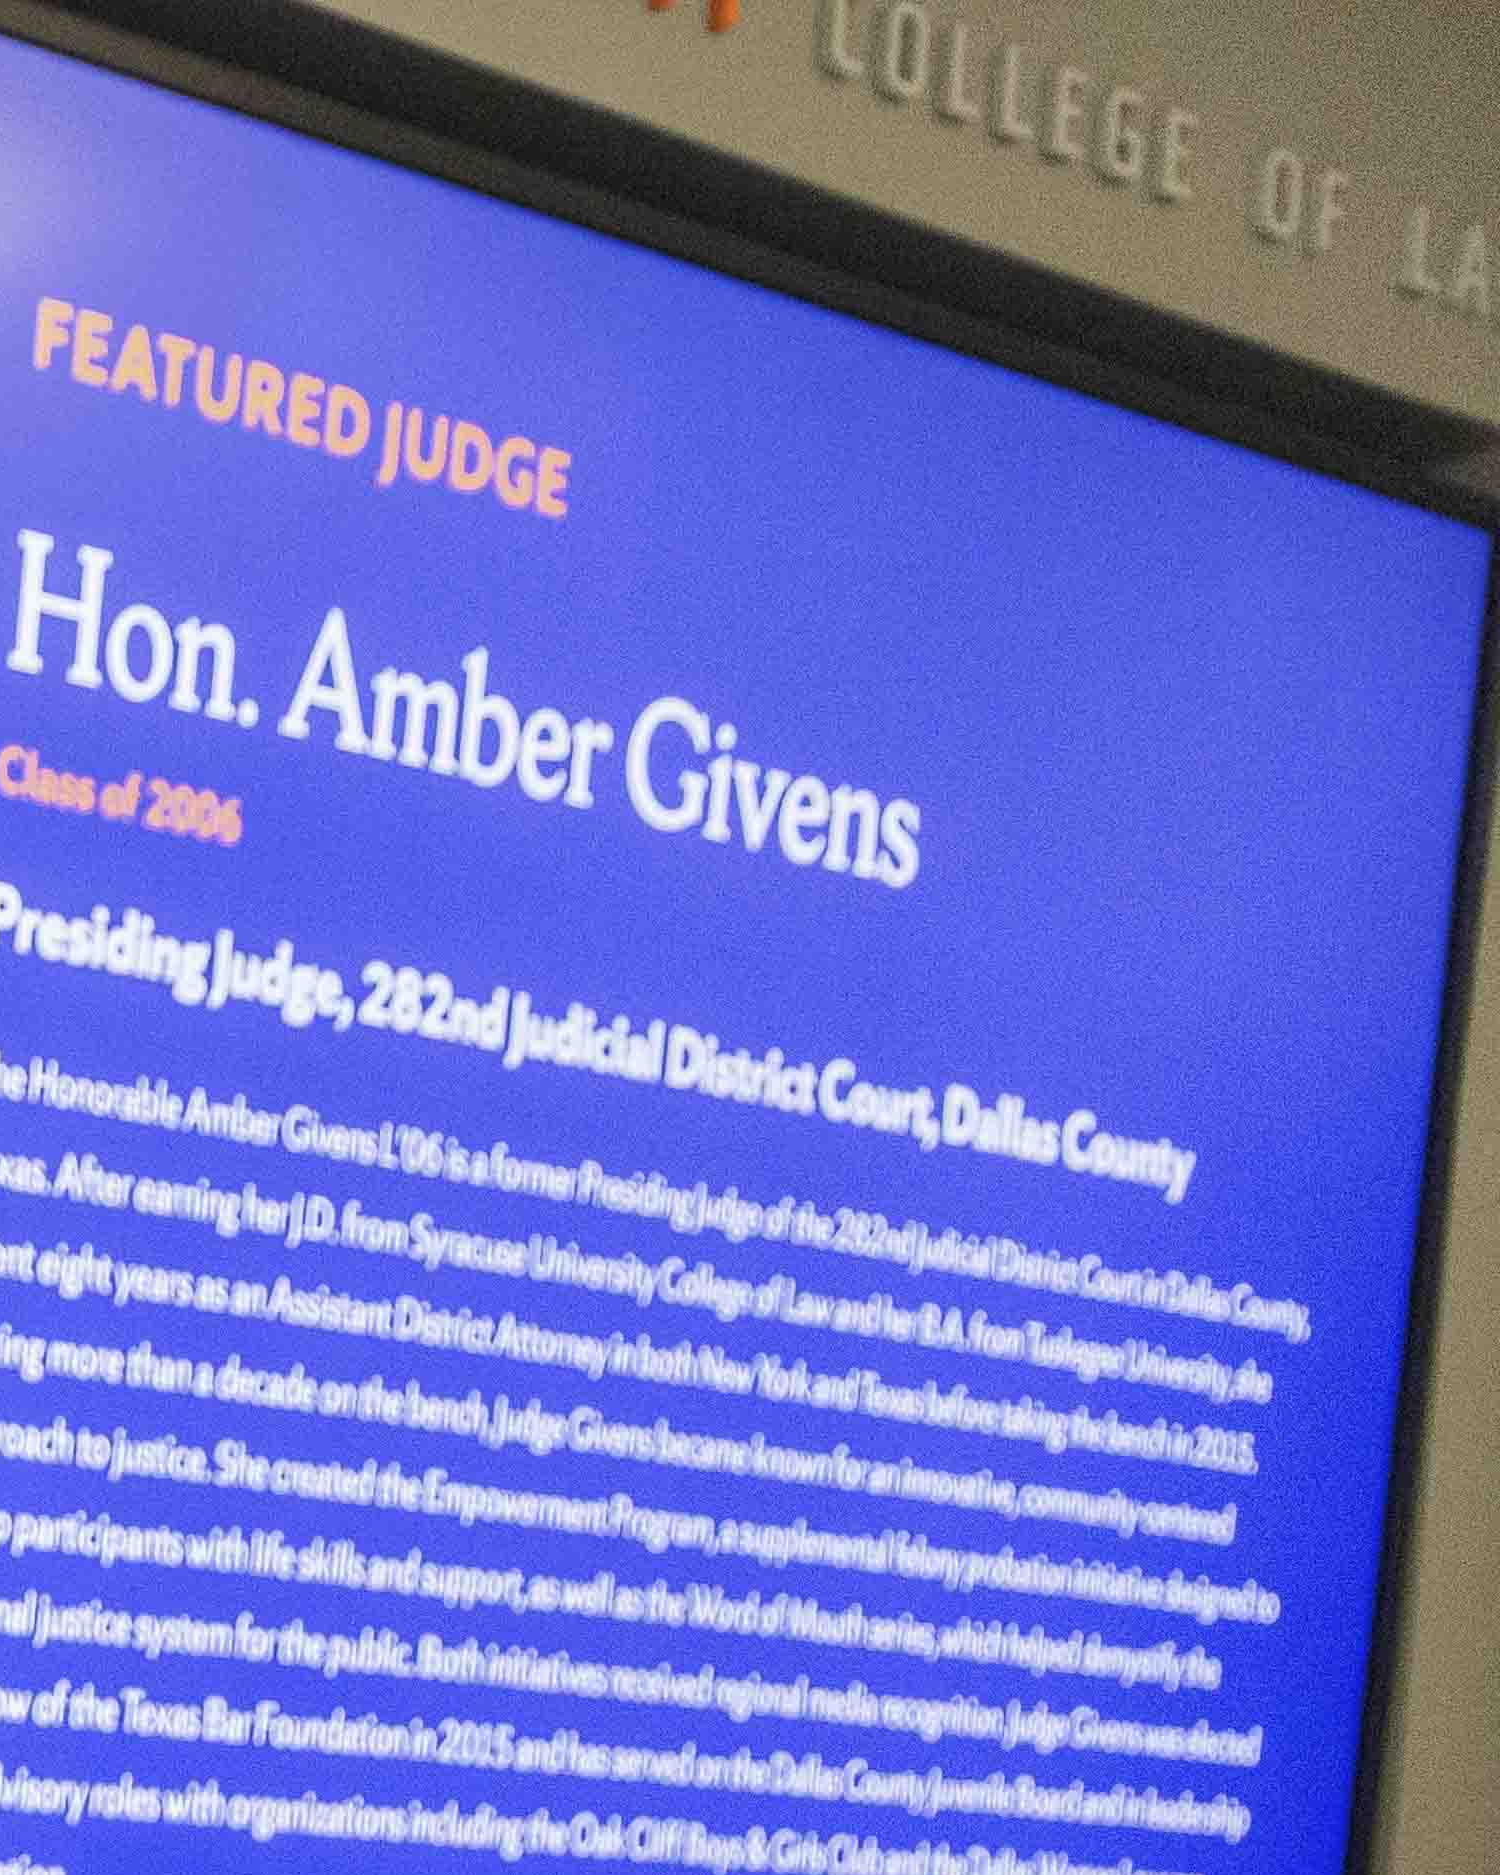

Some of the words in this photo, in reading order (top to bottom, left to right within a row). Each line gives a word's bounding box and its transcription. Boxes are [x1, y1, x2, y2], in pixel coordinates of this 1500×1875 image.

[1260, 148, 1350, 253] OF
[33, 296, 371, 457] FEATURED
[376, 402, 572, 519] JUDGE
[6, 529, 259, 728] Hon.
[277, 607, 613, 809] Amber
[625, 695, 921, 889] Givens
[99, 772, 142, 822] of
[145, 779, 244, 846] 2006
[206, 929, 355, 1032] Judge,
[357, 961, 510, 1051] 282nd
[505, 991, 665, 1080] Judicial
[665, 1025, 818, 1117] District
[818, 1057, 939, 1150] Court,
[940, 1084, 1060, 1166] Dallas
[1061, 1109, 1196, 1204] County
[25, 1058, 183, 1131] Honorable
[180, 1087, 284, 1149] Amber
[281, 1105, 378, 1165] Givens
[441, 1135, 471, 1182] is
[467, 1151, 490, 1185] a
[488, 1143, 580, 1201] former
[51, 1150, 134, 1208] After
[131, 1175, 242, 1236] earning
[240, 1183, 290, 1234] her
[283, 1190, 339, 1247] J.D.
[340, 1200, 409, 1254] from
[407, 1211, 530, 1274] Syracuse
[37, 1241, 115, 1300] eight
[109, 1262, 195, 1307] years
[193, 1275, 231, 1312] as
[230, 1281, 268, 1318] an
[268, 1275, 392, 1337] Assistant
[392, 1295, 496, 1352] District
[491, 1310, 612, 1379] Attorney
[45, 1339, 123, 1383] more
[123, 1341, 194, 1393] than
[192, 1361, 215, 1396] a
[214, 1352, 319, 1410] decade
[316, 1379, 358, 1416] on
[356, 1375, 407, 1422] the
[403, 1380, 492, 1439] bench,
[487, 1392, 569, 1452] Judge
[74, 1426, 110, 1470] to
[107, 1425, 212, 1483] justice.
[211, 1439, 271, 1490] She
[268, 1458, 378, 1504] created
[374, 1462, 422, 1510] the
[420, 1467, 610, 1533] Empowerment
[10, 1508, 186, 1568] participants
[184, 1525, 251, 1573] with
[248, 1530, 296, 1578] life
[293, 1537, 367, 1586] skills
[365, 1548, 422, 1593] and
[418, 1562, 527, 1610] support,
[561, 1572, 616, 1615] well
[32, 1591, 131, 1647] justice
[133, 1612, 234, 1659] system
[230, 1613, 278, 1661] for
[276, 1619, 326, 1666] the
[323, 1626, 416, 1678] public.
[415, 1633, 486, 1682] Both
[483, 1640, 608, 1695] initiatives
[31, 1680, 74, 1727] of
[68, 1683, 121, 1731] the
[117, 1687, 202, 1739] Texas
[201, 1695, 256, 1743] Bar
[252, 1700, 407, 1757] Foundation
[406, 1715, 440, 1760] in
[435, 1718, 514, 1767] 2015
[513, 1728, 567, 1772] and
[87, 1773, 162, 1821] roles
[160, 1779, 228, 1826] with
[226, 1789, 409, 1841] organizations
[405, 1798, 527, 1859] including
[524, 1809, 569, 1853] the
